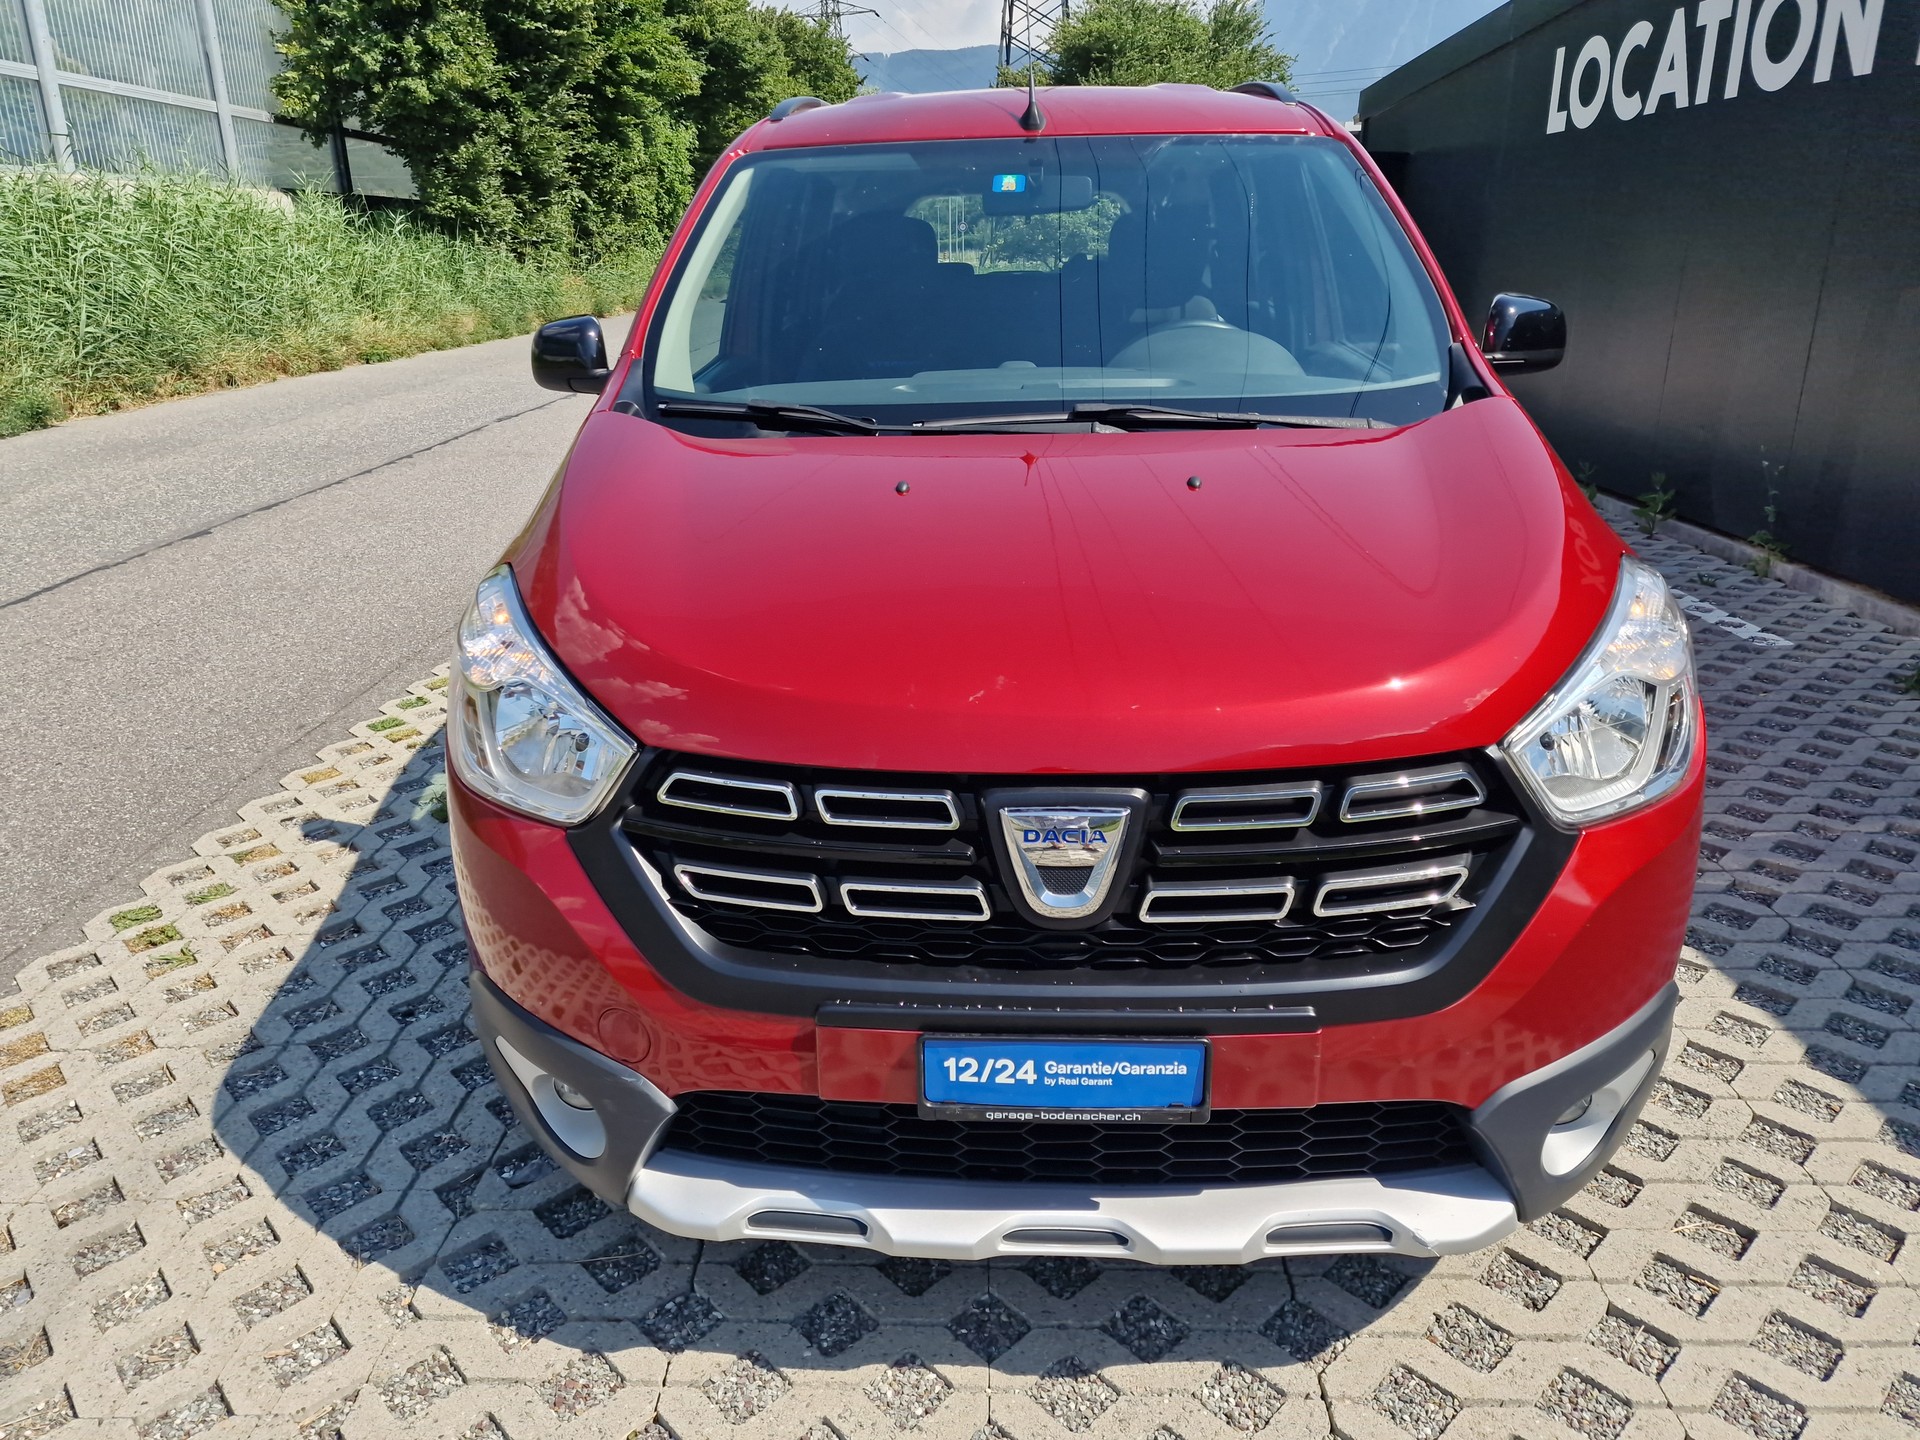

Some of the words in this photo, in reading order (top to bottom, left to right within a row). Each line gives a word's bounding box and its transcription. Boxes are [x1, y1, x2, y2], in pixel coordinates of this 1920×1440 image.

[1546, 0, 1885, 134] LOCATION
[1023, 829, 1107, 844] DACIA
[943, 1057, 1037, 1085] 12/24
[1044, 1060, 1187, 1076] Garantie/Garanzia
[1044, 1077, 1055, 1087] by
[1058, 1077, 1078, 1086] Real
[1081, 1077, 1113, 1086] Garant
[985, 1111, 1141, 1122] garage-bodenacker.ch
